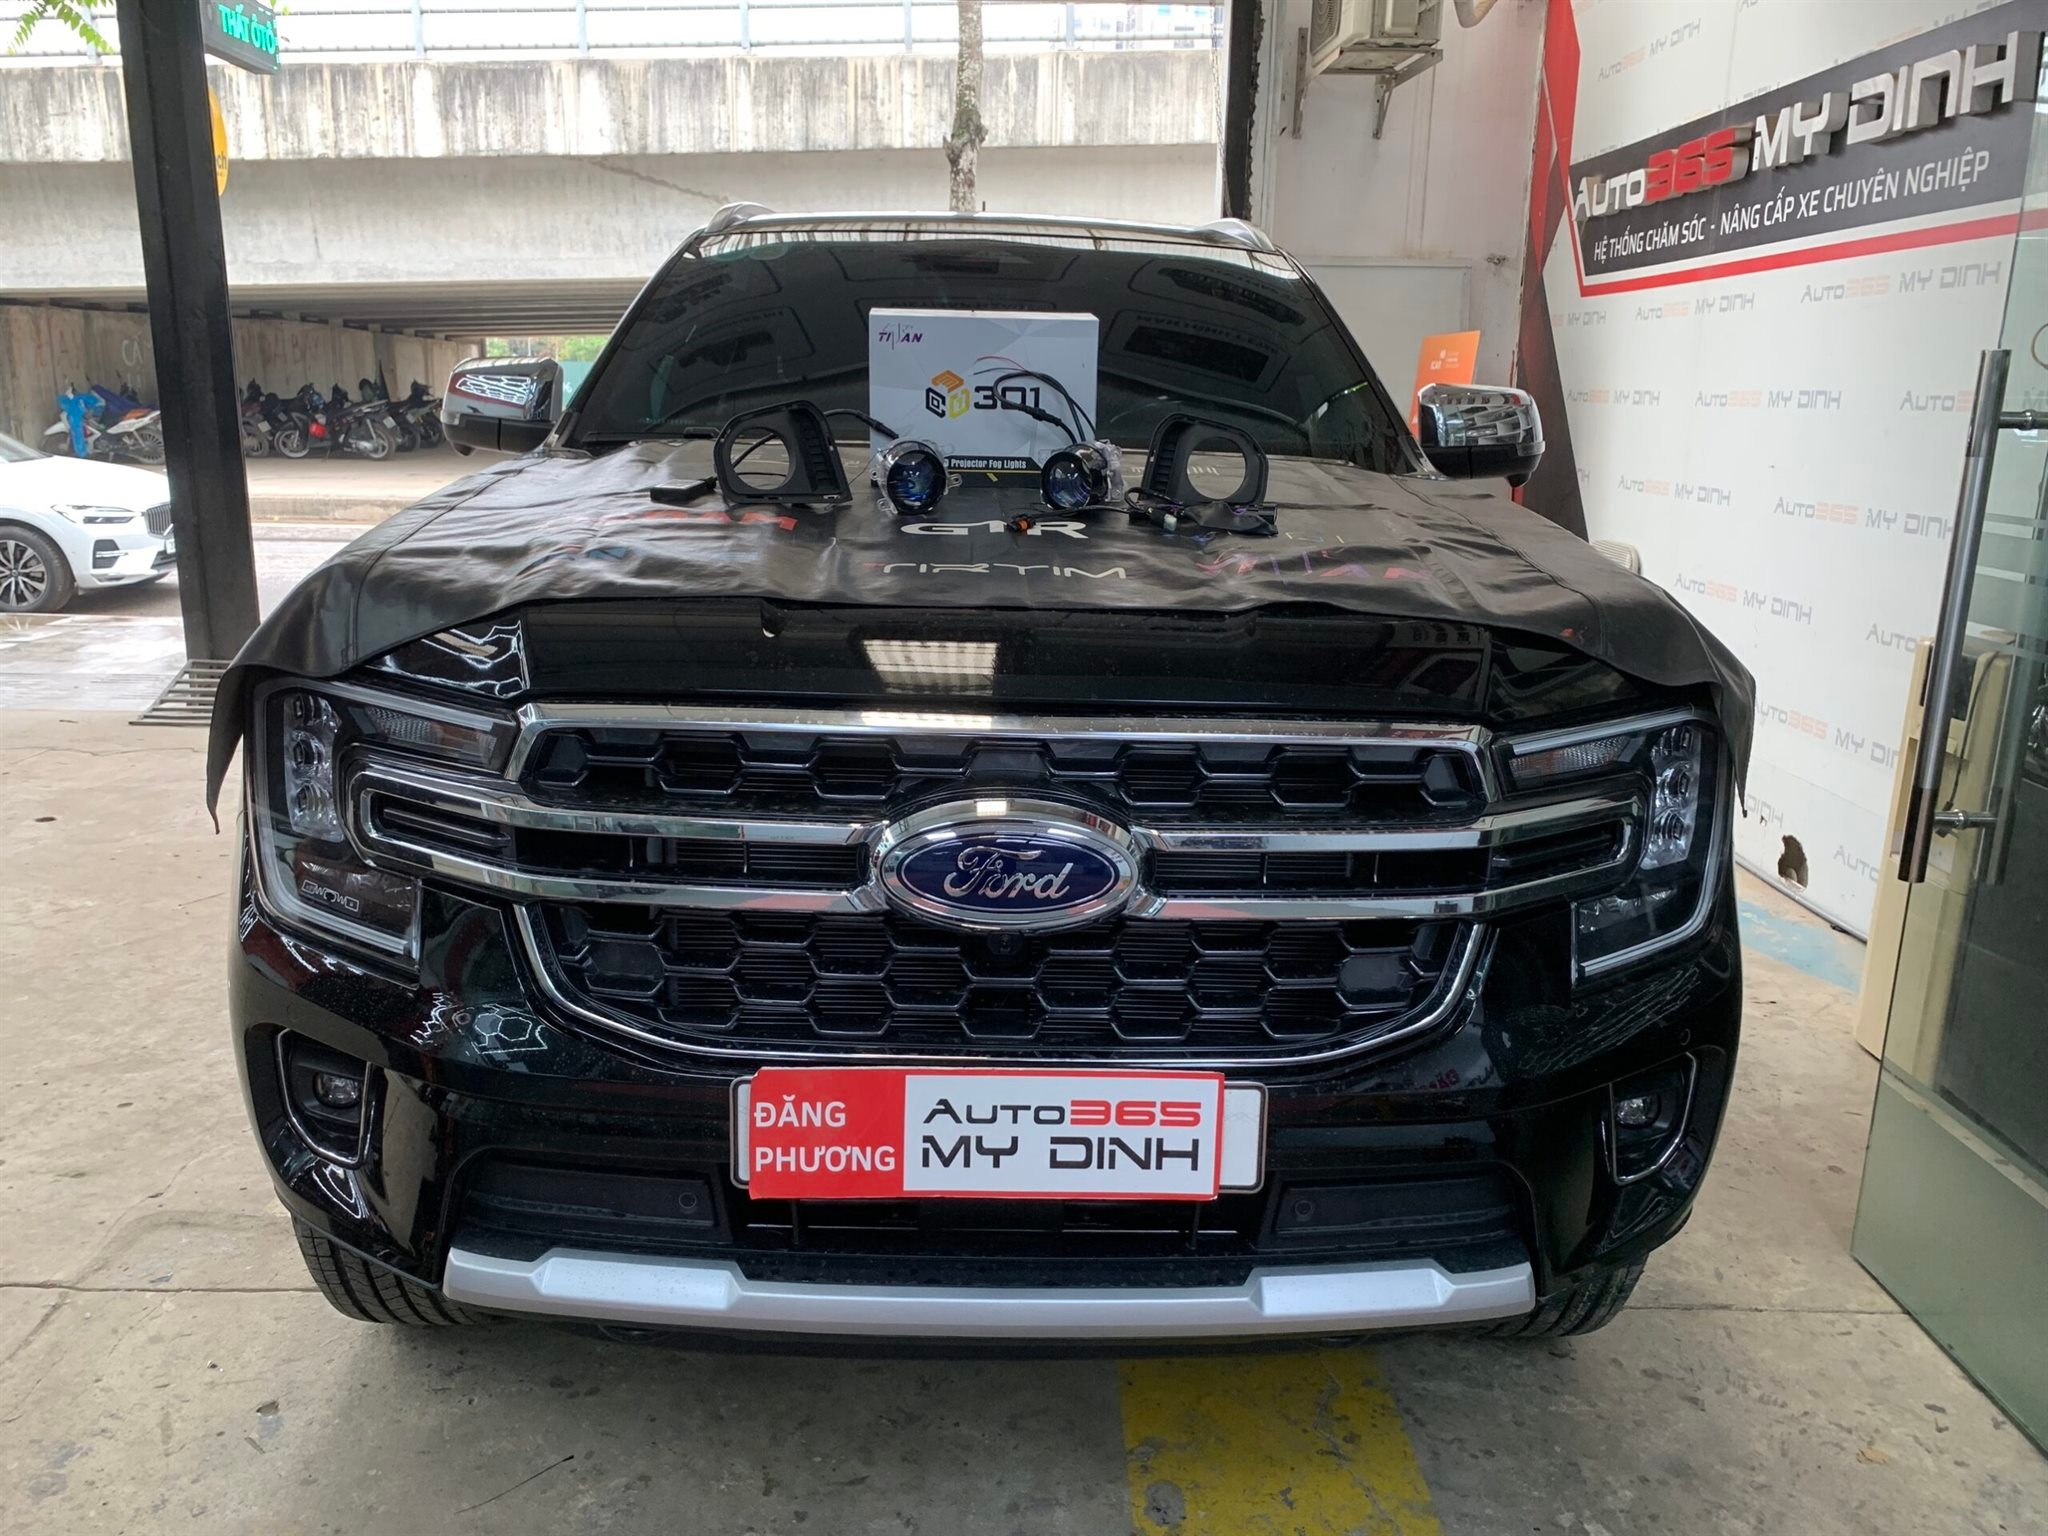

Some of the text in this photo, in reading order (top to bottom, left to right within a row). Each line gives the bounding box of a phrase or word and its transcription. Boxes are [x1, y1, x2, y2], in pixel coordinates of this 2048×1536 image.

[1752, 92, 1838, 171] MY
[1847, 31, 2025, 144] DINH
[1594, 236, 1608, 264] HỆ
[1610, 225, 1643, 255] THỐNG
[1646, 221, 1680, 250] CHĂM
[1681, 214, 1706, 244] SÓC
[1720, 204, 1761, 235] NÂNG
[1764, 186, 1795, 225] CẤP
[1797, 189, 1821, 219] XE
[1823, 168, 1900, 213] CHUYÊN
[1904, 146, 1990, 196] NGHIỆP
[1899, 269, 1934, 293] MY
[1940, 261, 2002, 289] DINH
[1695, 297, 1715, 315] MY
[1719, 293, 1755, 312] DINH
[1768, 391, 1793, 409] MY
[1798, 390, 1842, 410] DINH
[951, 459, 987, 469] Projector
[989, 460, 1002, 469] Fog
[1004, 460, 1026, 469] Lights
[1675, 483, 1694, 500] MY
[1697, 486, 1732, 506] DINH
[1865, 508, 1898, 530] MY
[1743, 590, 1767, 611] MY
[1770, 597, 1812, 625] DINH
[1835, 728, 1865, 753] MY
[943, 845, 1075, 899] Ford
[754, 1094, 847, 1129] ĐĂNG
[755, 1143, 896, 1173] PHƯƠNG
[921, 1134, 1200, 1172] MY DINH
